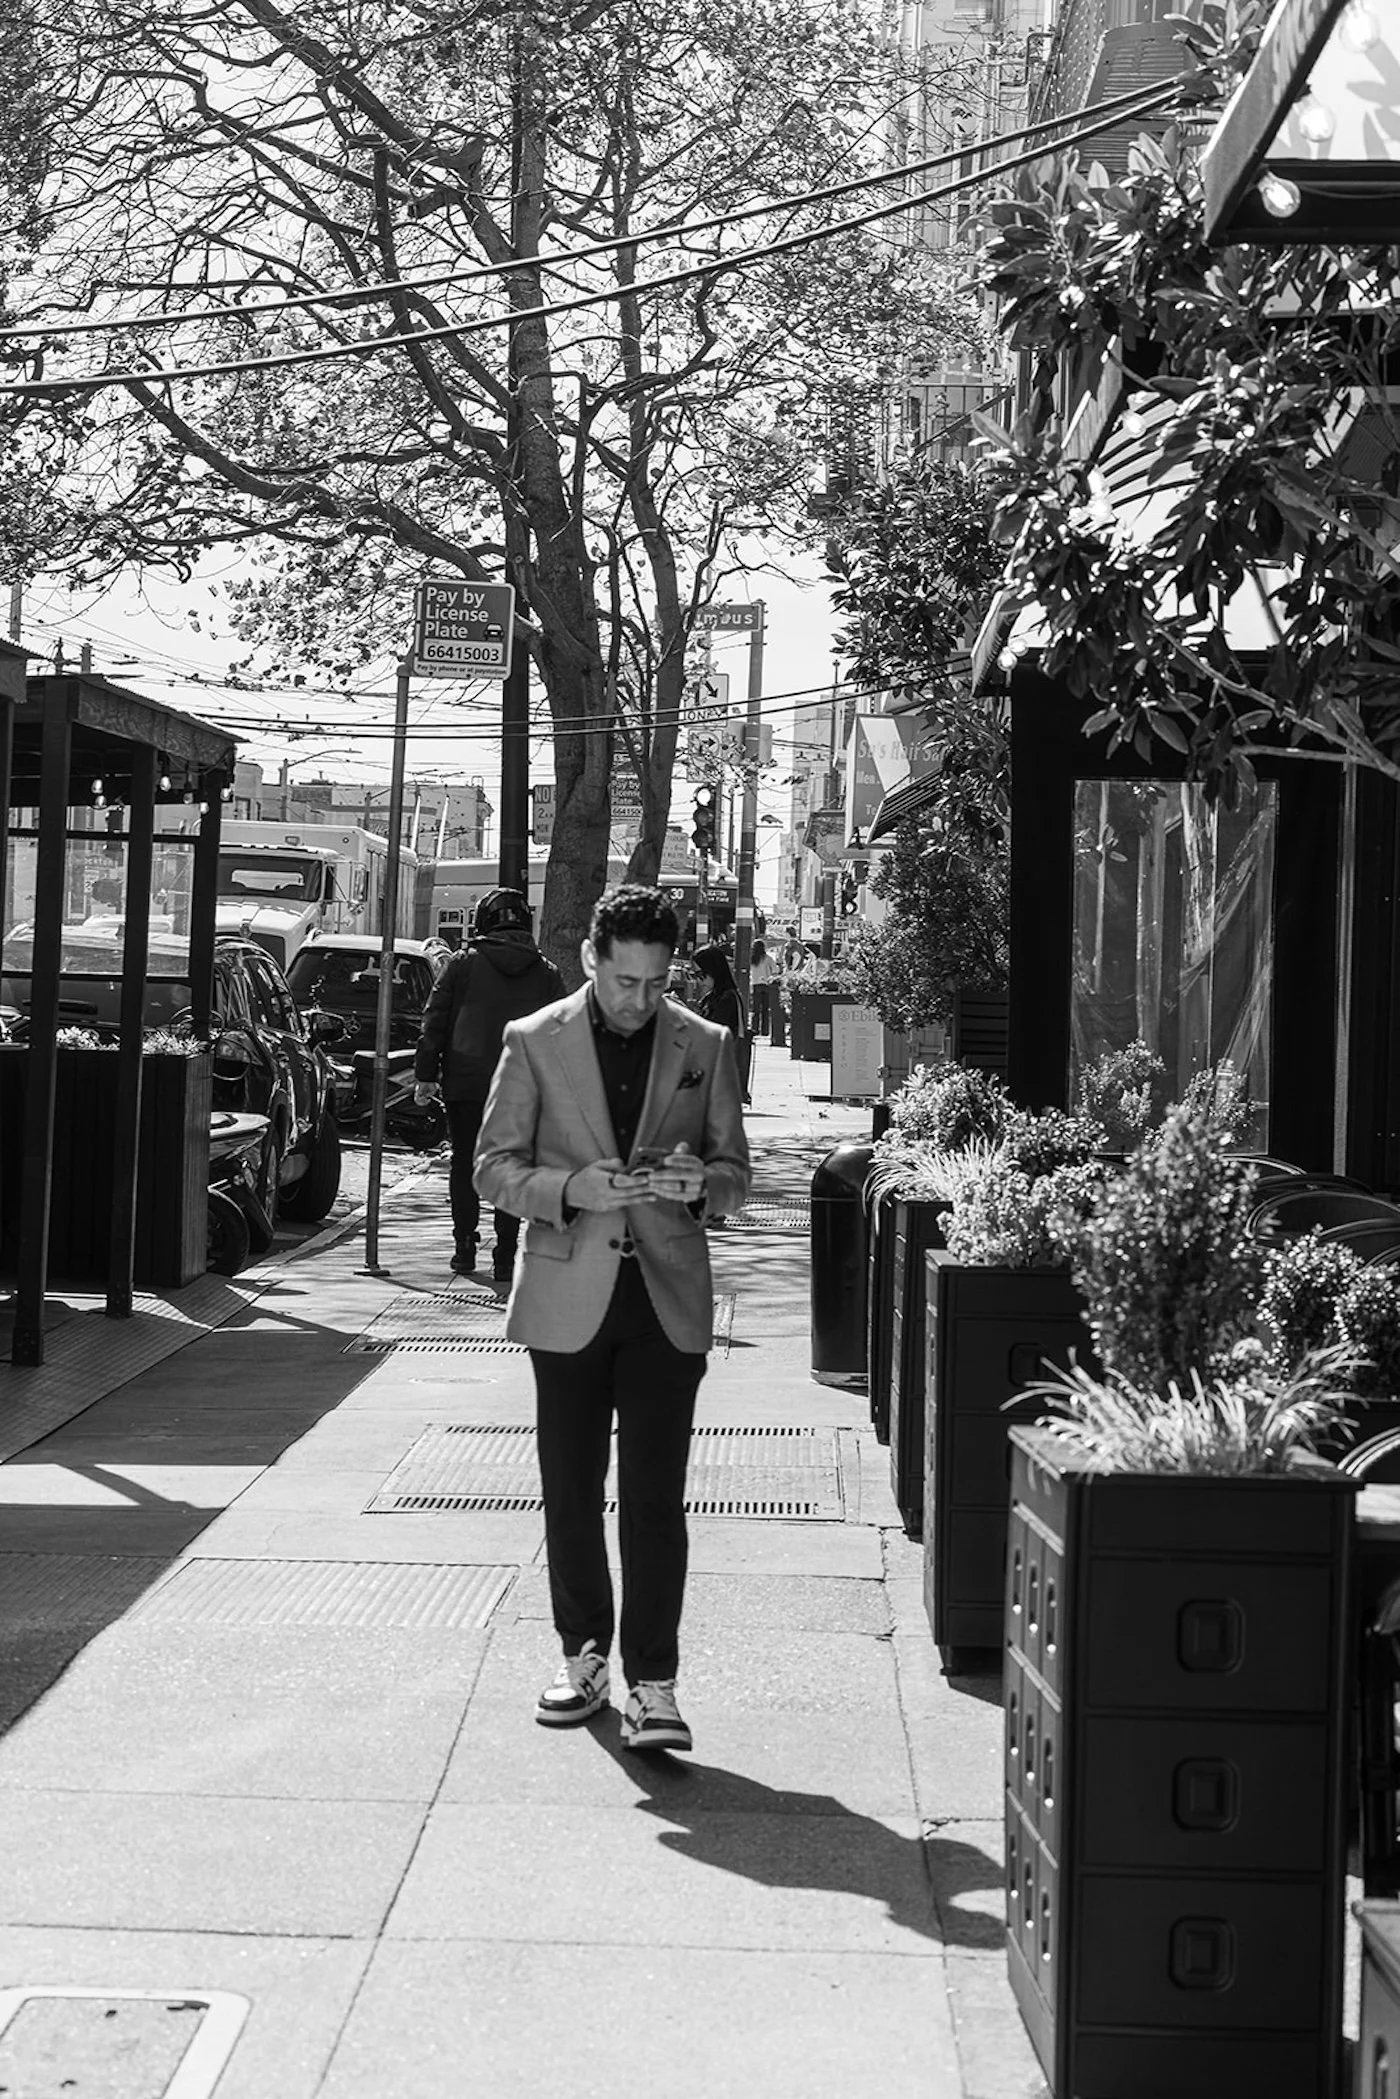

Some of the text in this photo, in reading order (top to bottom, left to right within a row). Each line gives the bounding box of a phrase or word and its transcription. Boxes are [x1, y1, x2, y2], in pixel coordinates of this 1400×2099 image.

[427, 586, 485, 608] Pay by
[426, 604, 489, 622] License
[425, 621, 468, 638] Plate
[427, 645, 499, 661] 66415003
[535, 786, 550, 803] NO
[670, 887, 684, 900] 30
